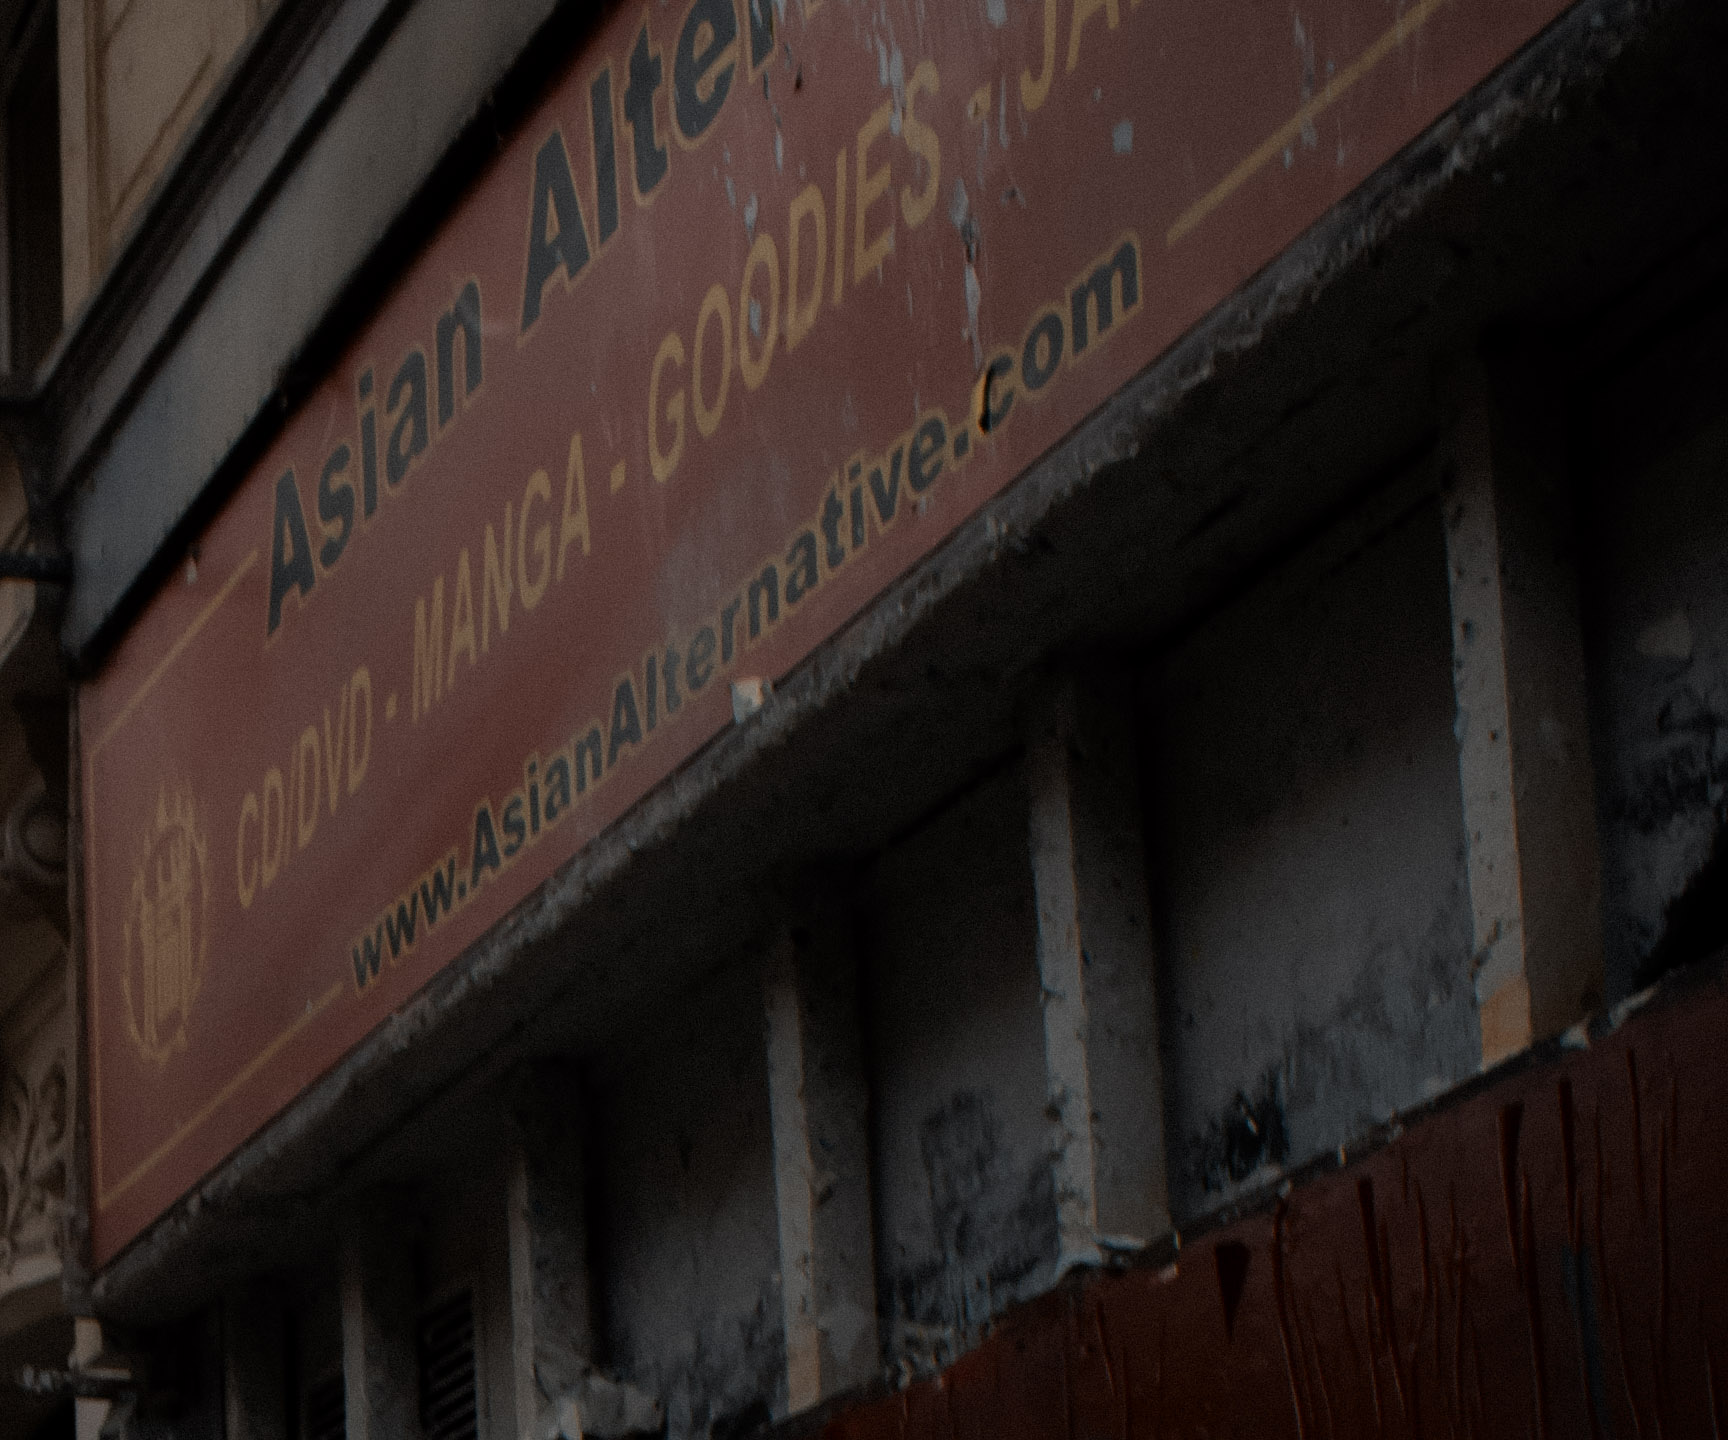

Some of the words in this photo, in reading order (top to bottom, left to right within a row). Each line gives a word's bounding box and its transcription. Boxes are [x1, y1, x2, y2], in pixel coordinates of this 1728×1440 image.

[235, 667, 373, 910] CD/DVD
[412, 432, 591, 727] MANGA
[647, 62, 941, 485] GOODIES
[265, 274, 484, 640] Asian
[350, 235, 1142, 990] www.AsianAlternative.com
